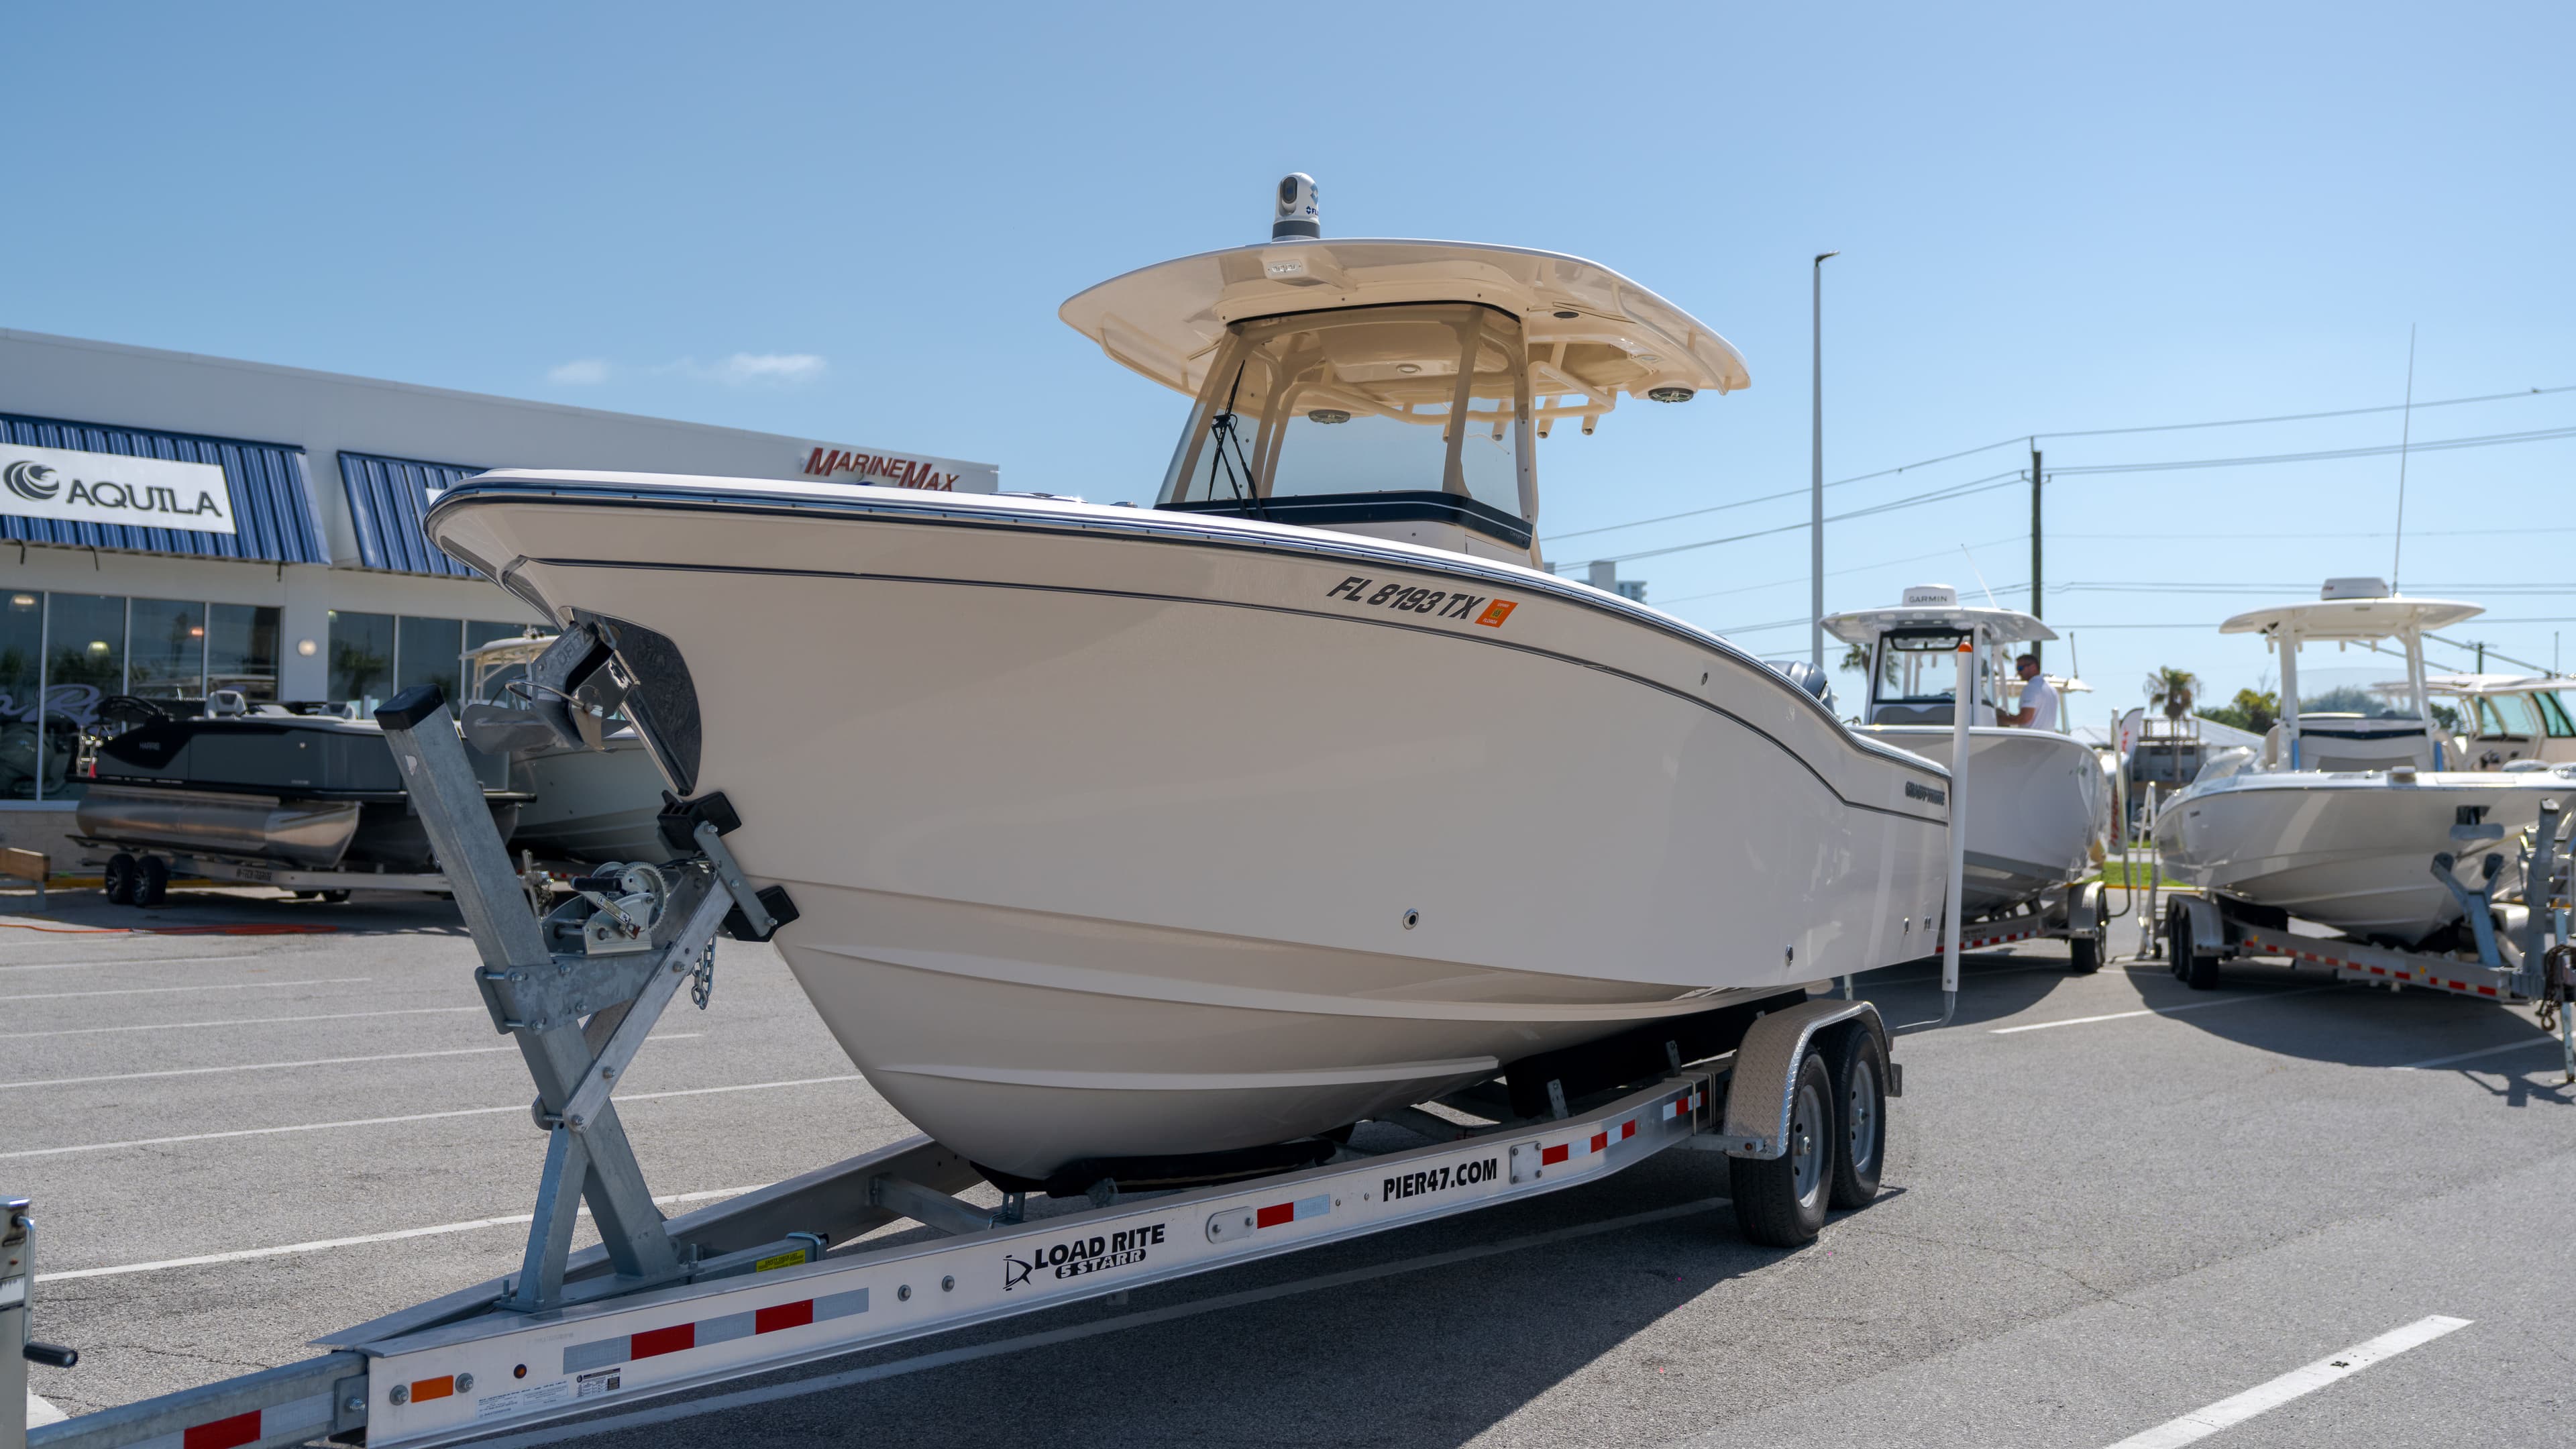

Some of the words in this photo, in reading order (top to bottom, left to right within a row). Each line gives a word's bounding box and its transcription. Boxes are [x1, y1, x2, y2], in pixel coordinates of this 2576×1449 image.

[66, 478, 223, 518] AQUILA
[1326, 576, 1373, 602] FL
[1366, 584, 1446, 613] 8193
[1437, 593, 1486, 619] TX
[1383, 1158, 1497, 1202] PIER47.COM
[1035, 1236, 1106, 1270] LOAD
[1112, 1224, 1165, 1253] RITE
[1061, 1265, 1072, 1279] 5
[1077, 1250, 1142, 1275] STARR
